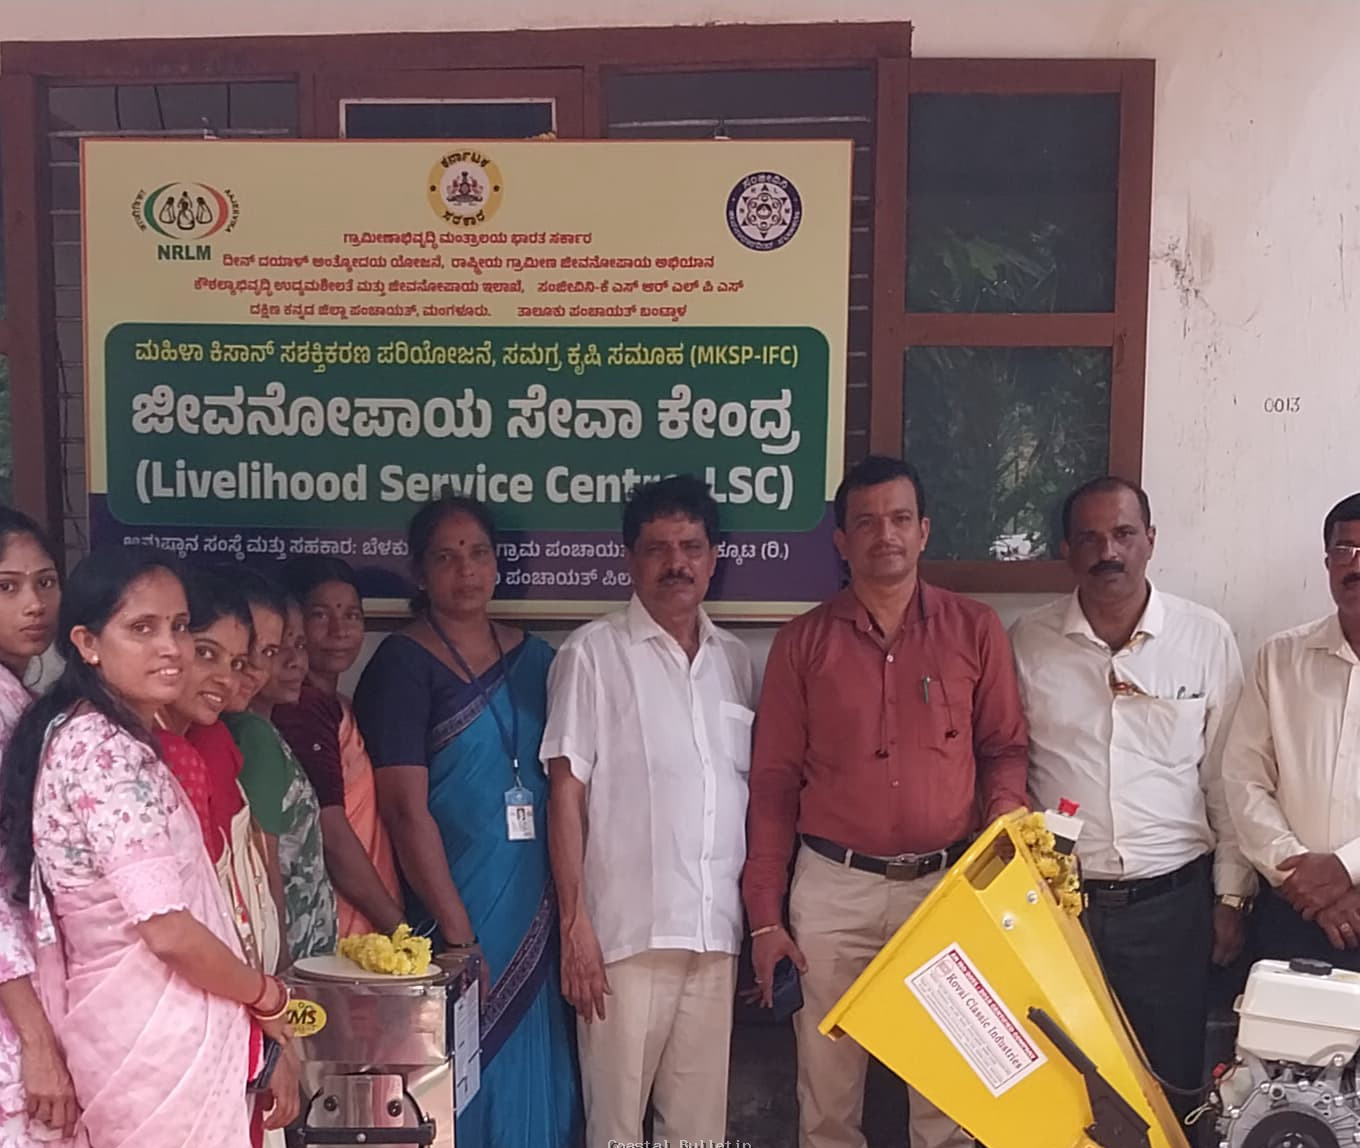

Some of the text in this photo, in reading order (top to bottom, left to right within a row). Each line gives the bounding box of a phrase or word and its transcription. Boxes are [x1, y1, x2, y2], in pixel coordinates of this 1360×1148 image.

[440, 151, 490, 168] ಕರ್ನಾಟಕ
[439, 231, 507, 248] ಮಂತ್ರಾಲಯ
[511, 232, 546, 246] ಭಾರತ
[549, 232, 592, 244] ಸರ್ಕಾರ
[157, 244, 211, 261] NRLM
[223, 254, 255, 266] ದೀನ್
[258, 255, 309, 267] ದಯಾಳ್
[506, 256, 557, 272] ಗ್ರಾಮೀಣ
[560, 255, 652, 268] ಜೀವನೋಪಾಯ
[655, 256, 715, 271] ಅಭಿಯಾನ
[356, 280, 386, 297] ಮತ್ತು
[388, 278, 479, 293] ಜೀವನೋಪಾಯ
[612, 280, 639, 292] ಎಸ್
[671, 280, 699, 292] ಎಲ್
[717, 280, 744, 292] ಎಸ್
[250, 303, 280, 319] ದಕ್ಷಿಣ
[283, 304, 315, 320] ಕನ್ನಡ
[318, 304, 348, 320] ಜಿಲ್ಲಾ
[569, 305, 637, 317] ಪಂಚಾಯತ್
[135, 339, 798, 375] ಮಹಿಳಾ ಕಿಸಾನ್ ಸಶಕ್ತಿಕರಣ ಪರಿಯೋಜನೆ, ಸಮಗ್ರ ಕೃಷಿ ಸಮೂಹ (MKSP-IFC)
[1264, 396, 1301, 413] 0013
[132, 382, 800, 454] ಜೀವನೋಪಾಯ ಸೇವಾ ಕೇಂದ್ರ
[136, 459, 368, 504] (Livelihood
[379, 462, 534, 503] Service
[246, 535, 287, 560] ಮತ್ತು
[290, 537, 357, 555] ಸಹಕಾರ:
[545, 540, 625, 558] ಪಂಚಾಯ
[761, 541, 789, 561] (ರಿ.)
[505, 568, 598, 586] ಪಂಚಾಯತ್
[966, 998, 990, 1029] Classic
[988, 1025, 1022, 1069] Industries
